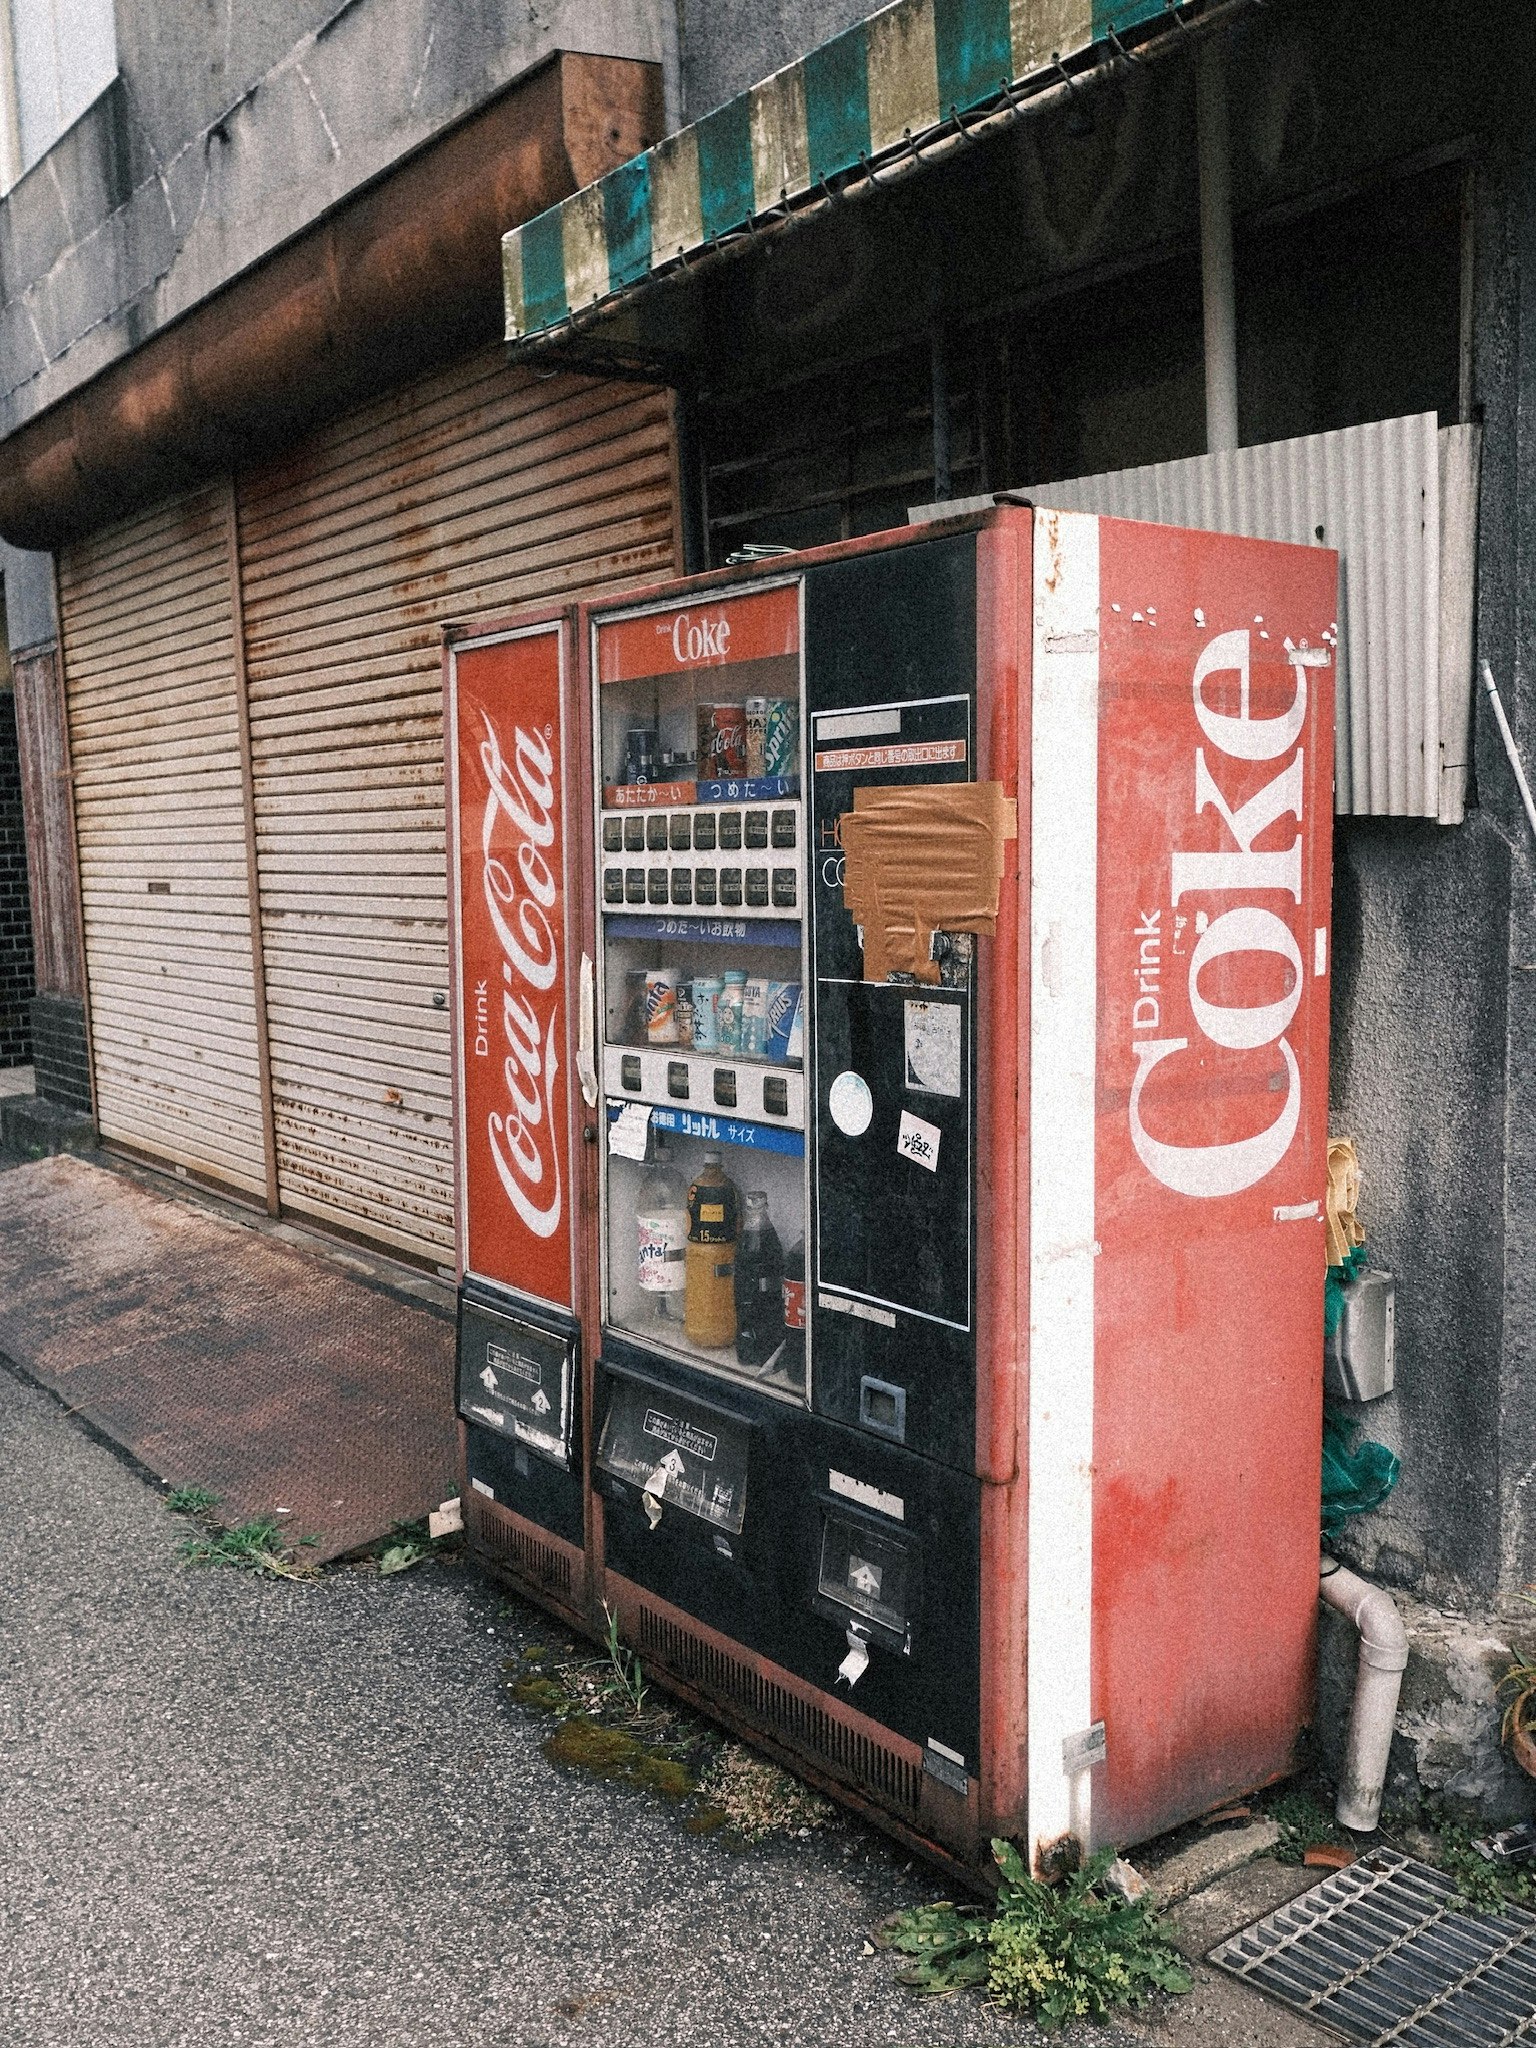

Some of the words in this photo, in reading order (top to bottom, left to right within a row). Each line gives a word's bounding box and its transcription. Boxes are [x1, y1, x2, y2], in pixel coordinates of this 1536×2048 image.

[673, 615, 731, 663] Coke
[1129, 629, 1308, 1198] Coke
[1133, 909, 1160, 1029] Drink
[475, 979, 489, 1057] Drink
[681, 1113, 720, 1140] リットル
[728, 1124, 755, 1144] サイズ
[669, 1458, 677, 1472] 3
